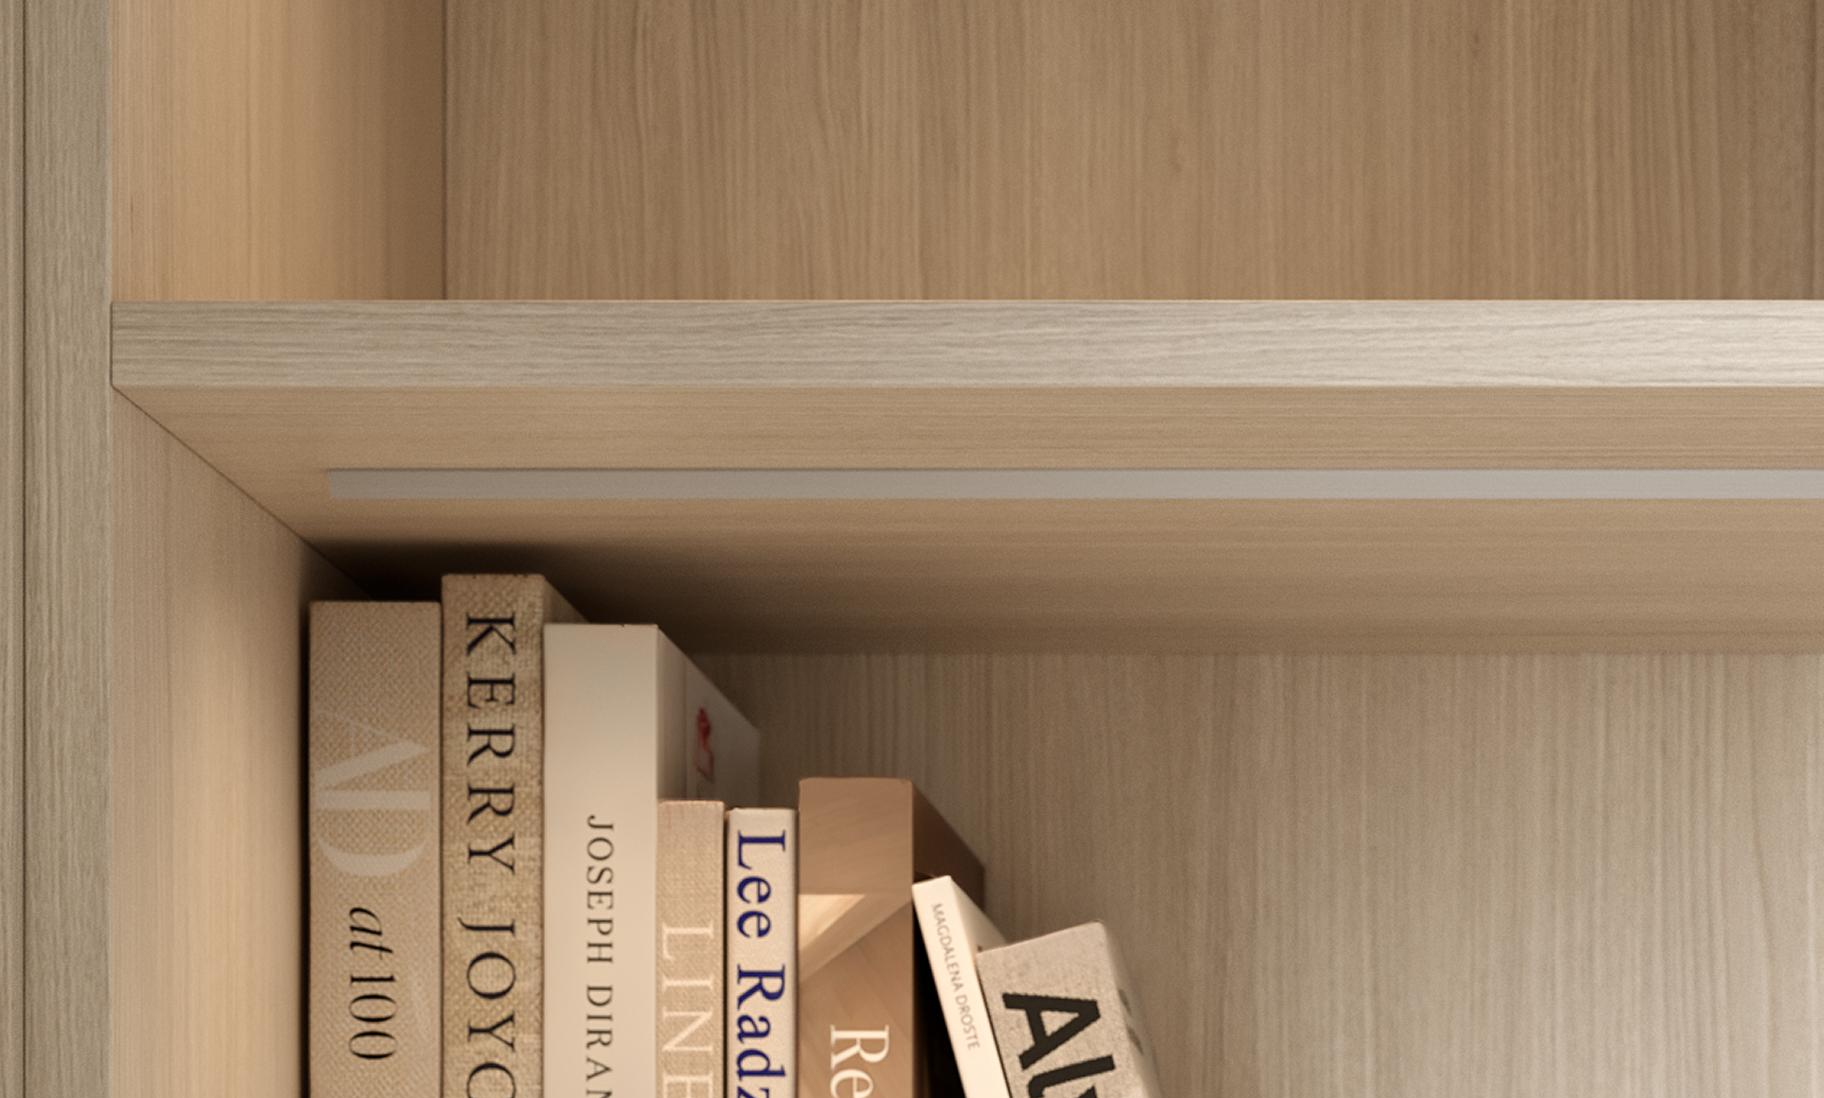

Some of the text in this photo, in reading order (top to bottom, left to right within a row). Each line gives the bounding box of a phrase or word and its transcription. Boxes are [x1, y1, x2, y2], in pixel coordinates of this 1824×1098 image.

[465, 613, 516, 873] KERRY
[349, 907, 395, 958] at
[586, 815, 614, 964] JOSEPH
[736, 830, 786, 939] Lee
[349, 975, 396, 1060] 100
[932, 903, 980, 1050] MAGDALENA DROSTE
